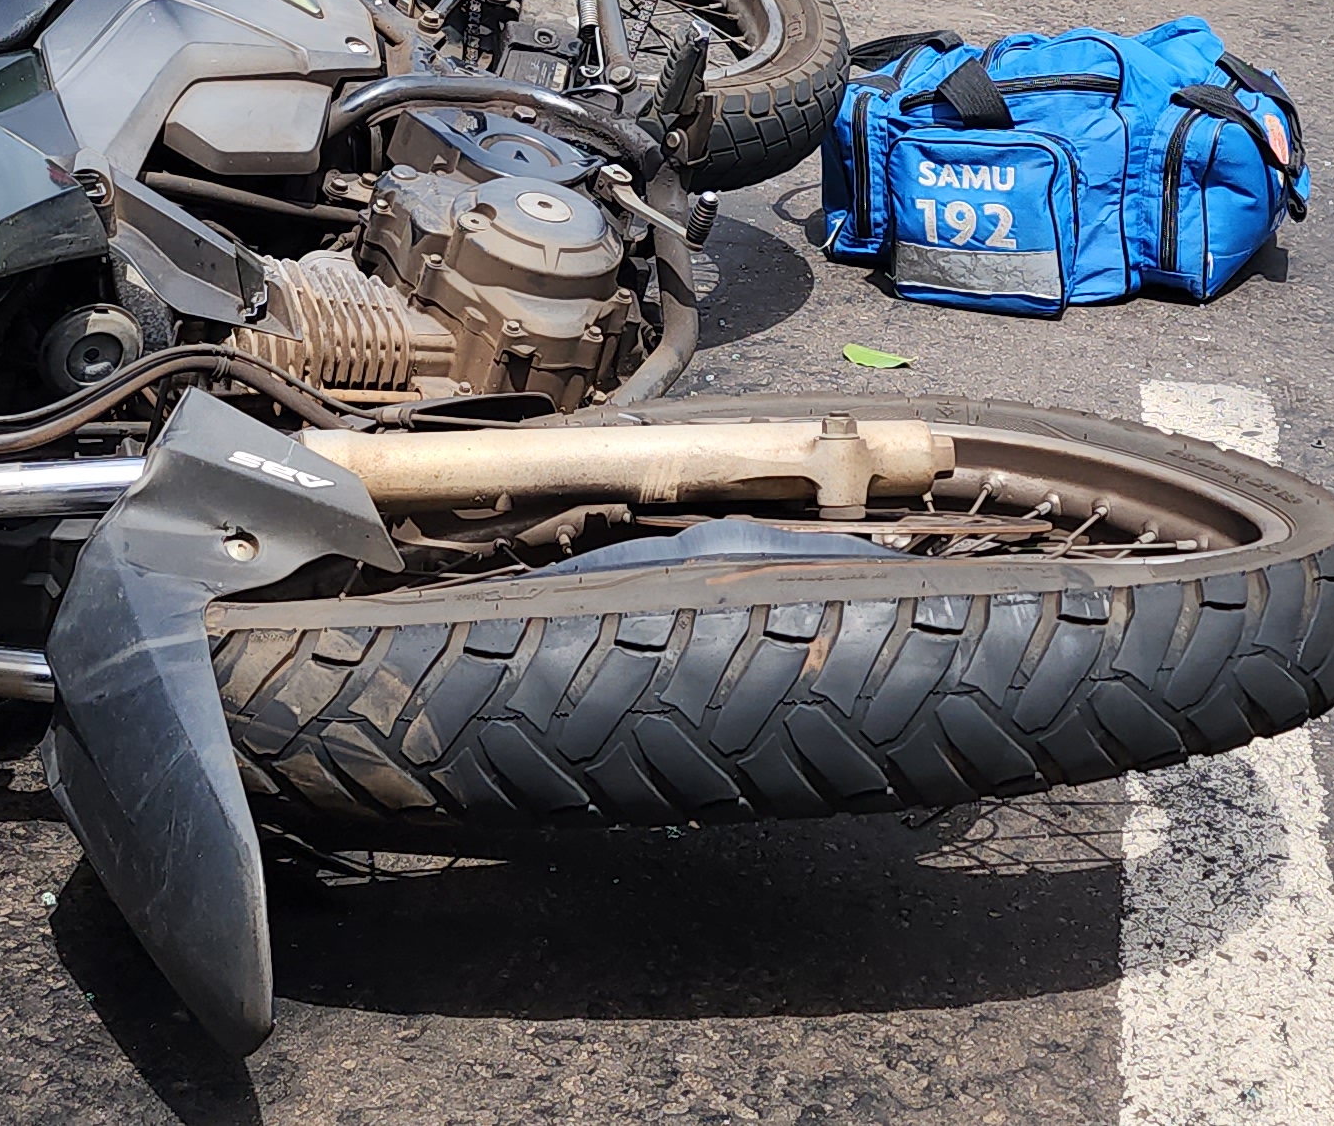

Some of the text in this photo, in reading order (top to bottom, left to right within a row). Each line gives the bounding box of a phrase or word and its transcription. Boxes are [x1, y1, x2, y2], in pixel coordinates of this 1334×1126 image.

[917, 160, 1015, 191] SAMU
[914, 198, 1017, 250] 192
[227, 450, 336, 489] ABS
